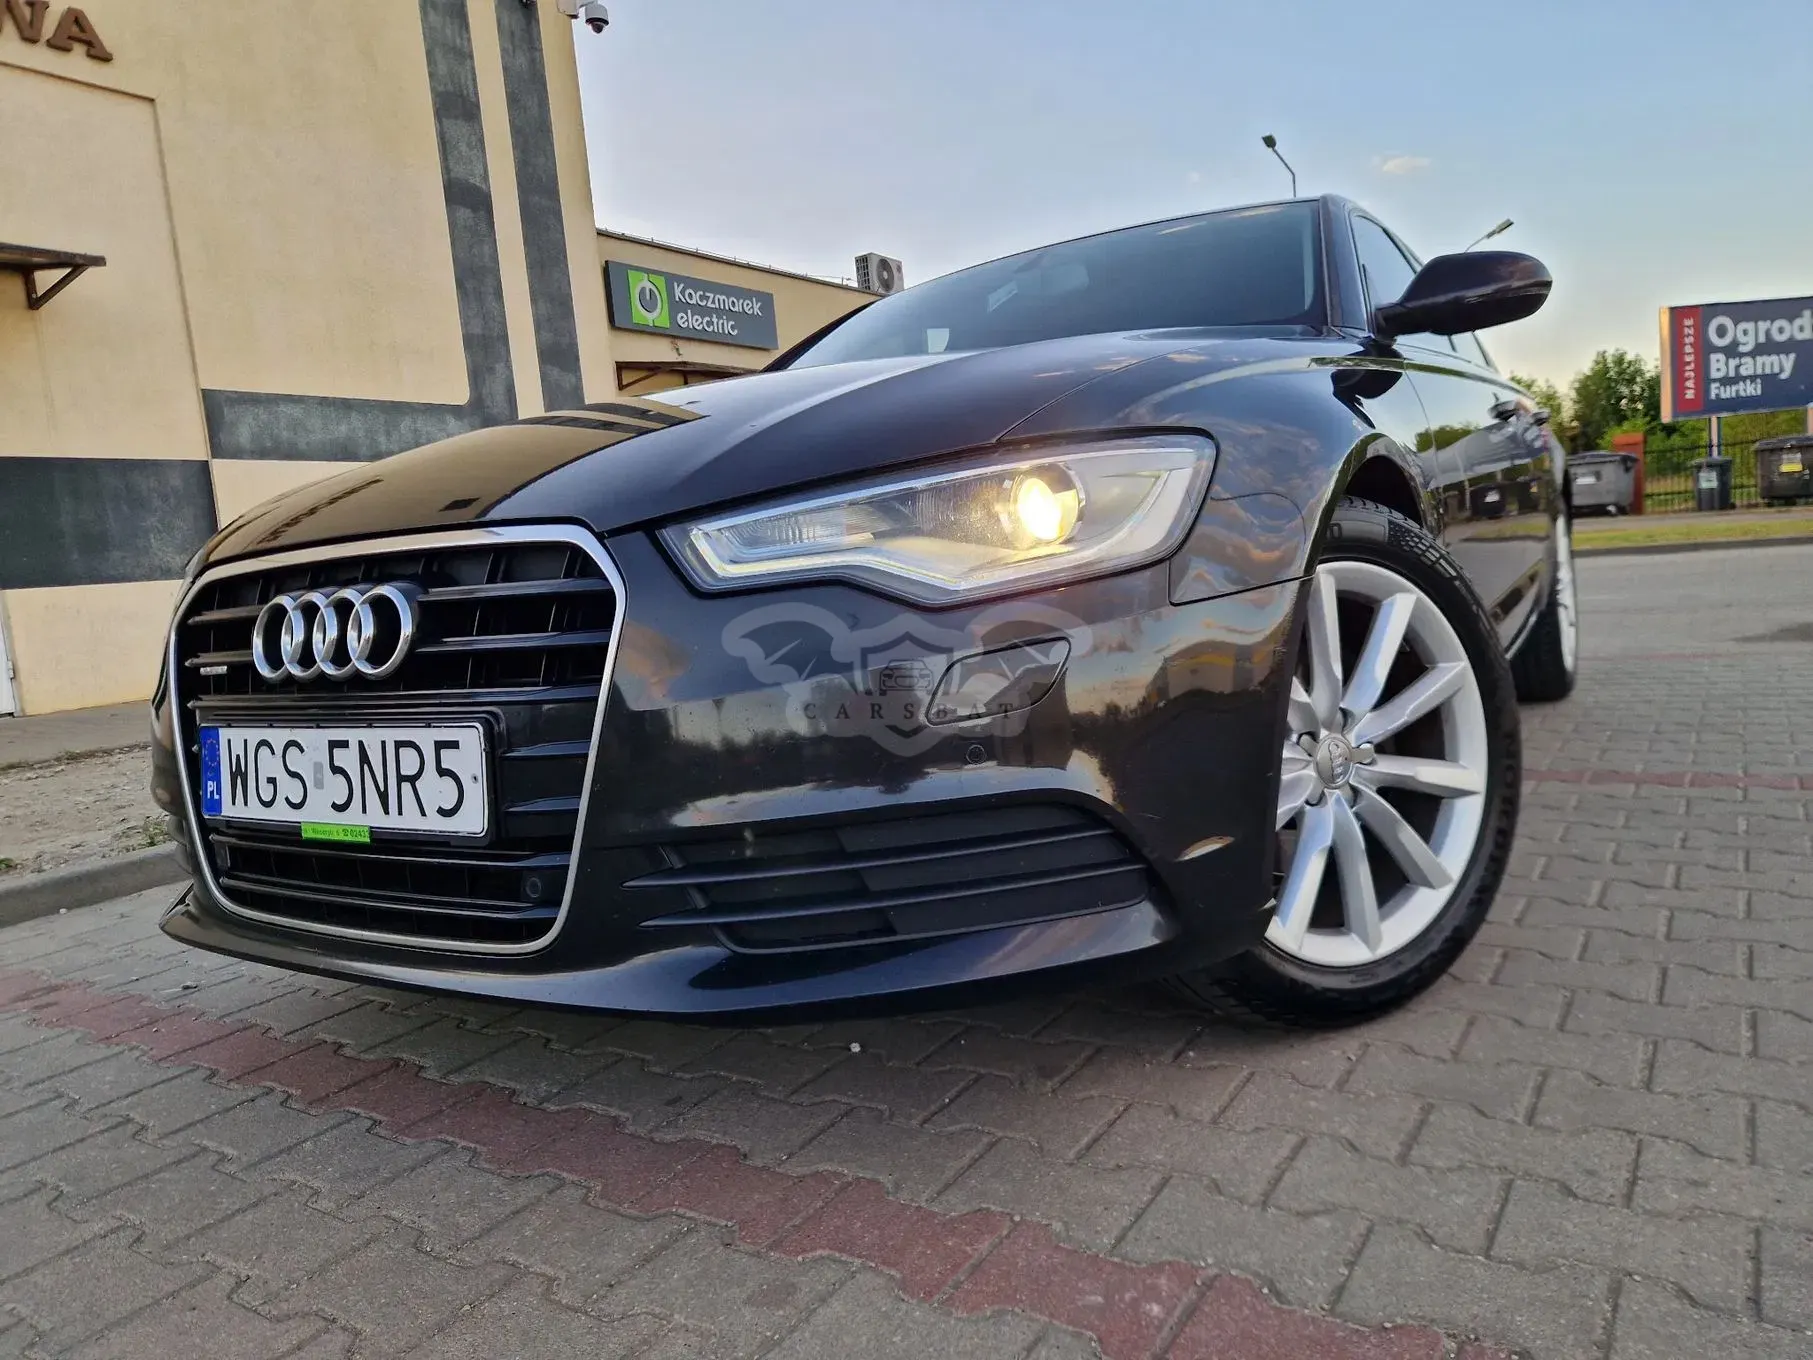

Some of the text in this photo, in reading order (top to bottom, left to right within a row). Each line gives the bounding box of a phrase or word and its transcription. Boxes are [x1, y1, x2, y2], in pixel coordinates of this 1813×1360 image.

[673, 281, 763, 316] Kaczmarek
[676, 309, 739, 336] electric
[1708, 309, 1813, 353] Ogrod
[1709, 352, 1797, 380] Bramy
[1710, 377, 1763, 400] Furtki
[207, 780, 221, 800] PL
[227, 738, 466, 819] WGS 5NR5
